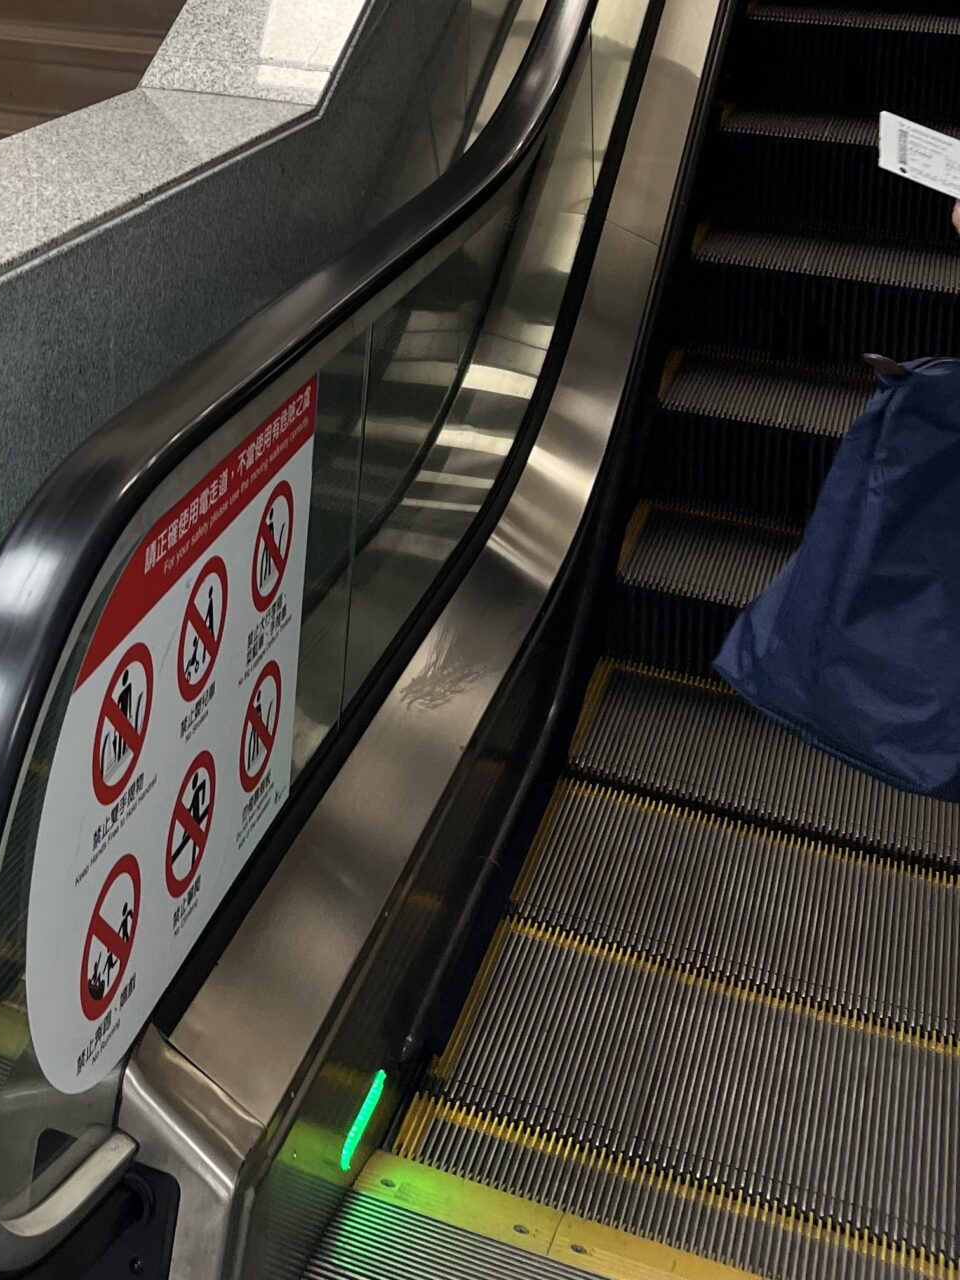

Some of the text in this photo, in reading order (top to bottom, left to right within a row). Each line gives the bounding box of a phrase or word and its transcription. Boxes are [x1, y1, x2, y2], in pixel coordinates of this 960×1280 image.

[163, 553, 175, 574] For
[176, 540, 191, 565] your
[191, 523, 208, 547] safety
[209, 501, 228, 530] please
[229, 492, 240, 506] use
